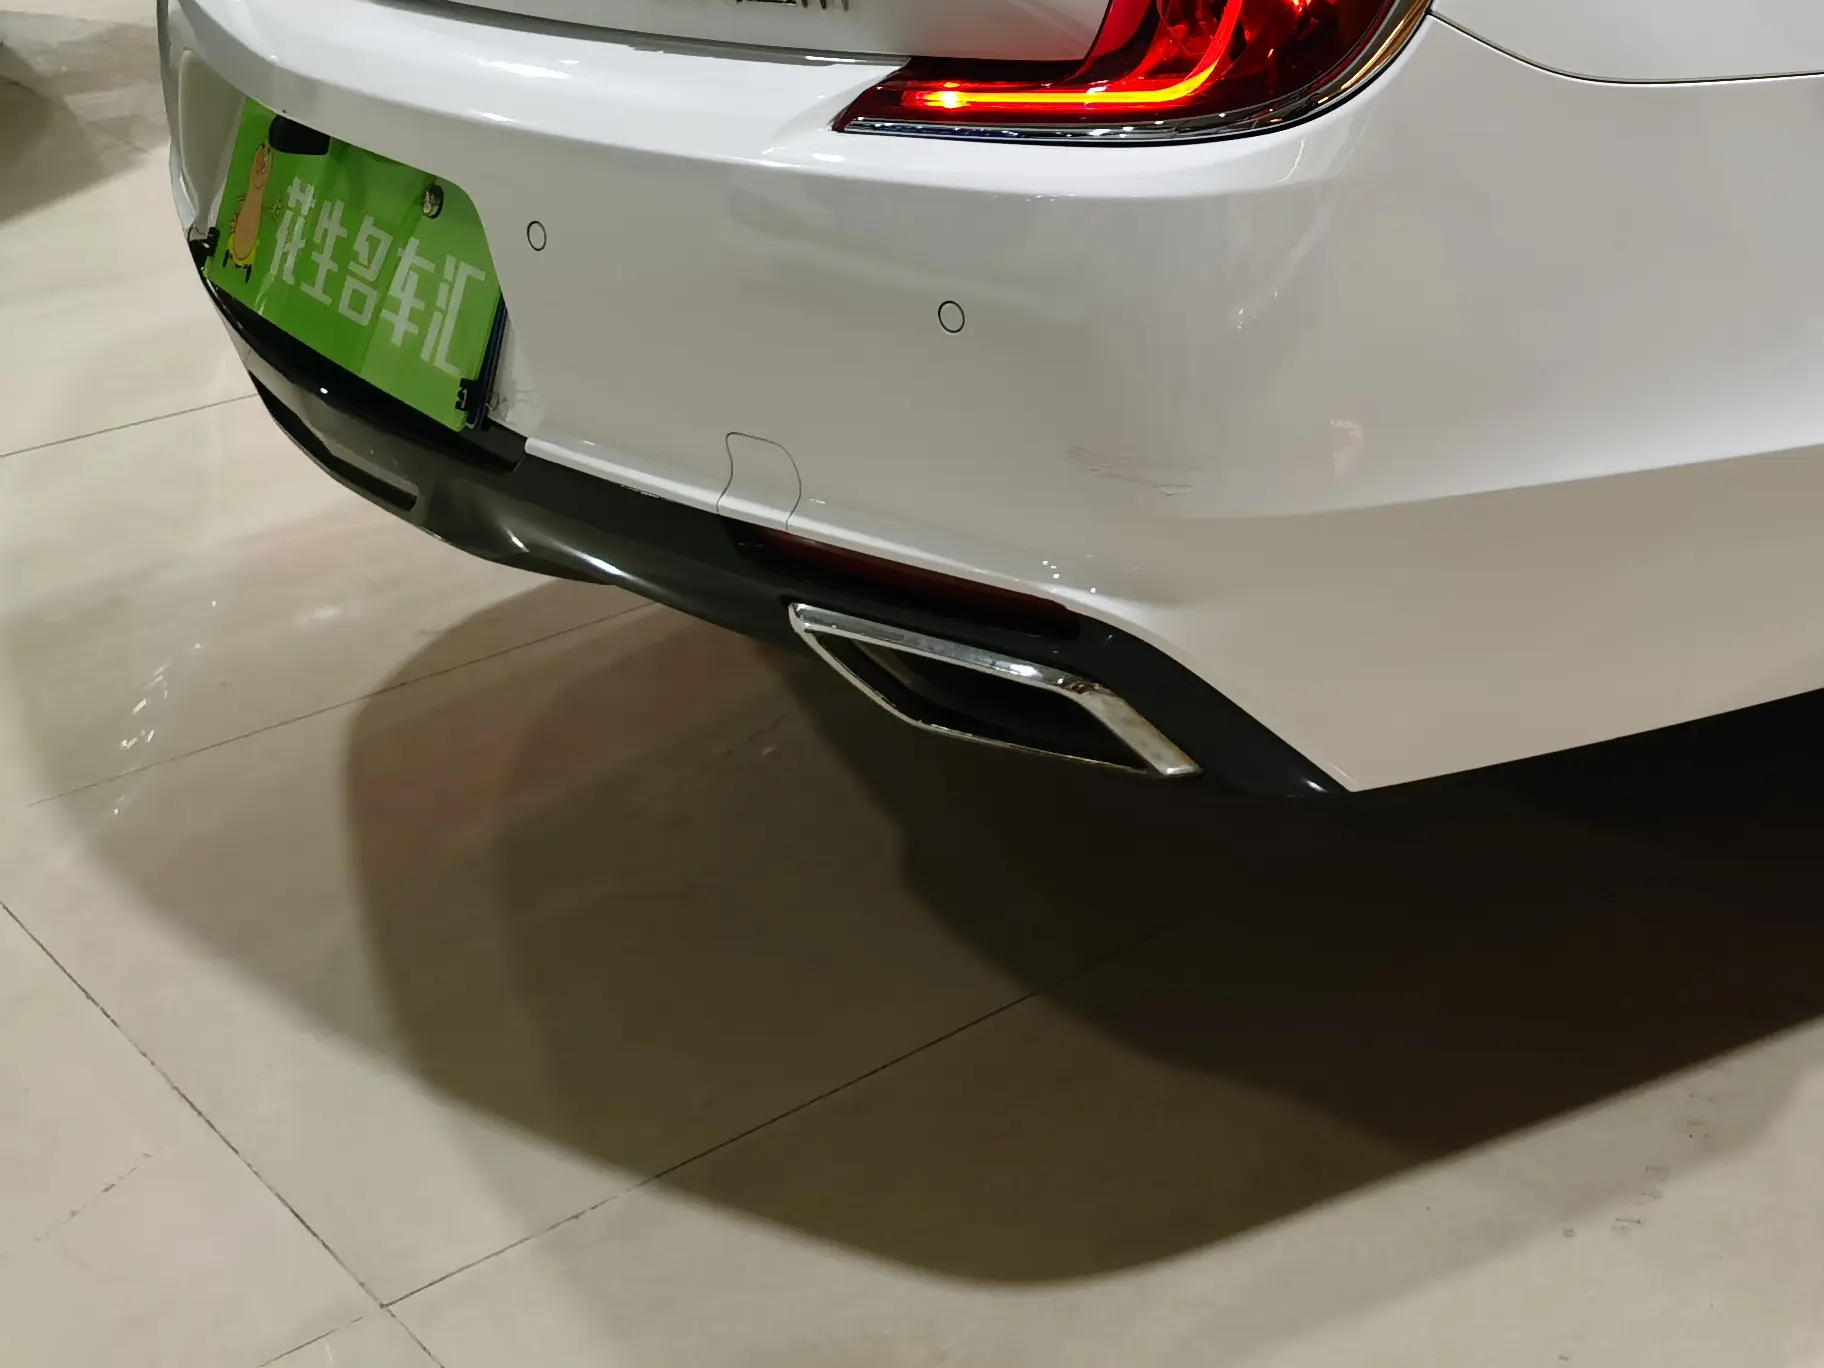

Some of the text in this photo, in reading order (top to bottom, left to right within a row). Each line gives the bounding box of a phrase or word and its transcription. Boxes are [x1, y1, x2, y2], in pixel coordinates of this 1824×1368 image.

[270, 175, 486, 378] 花生名车汇
